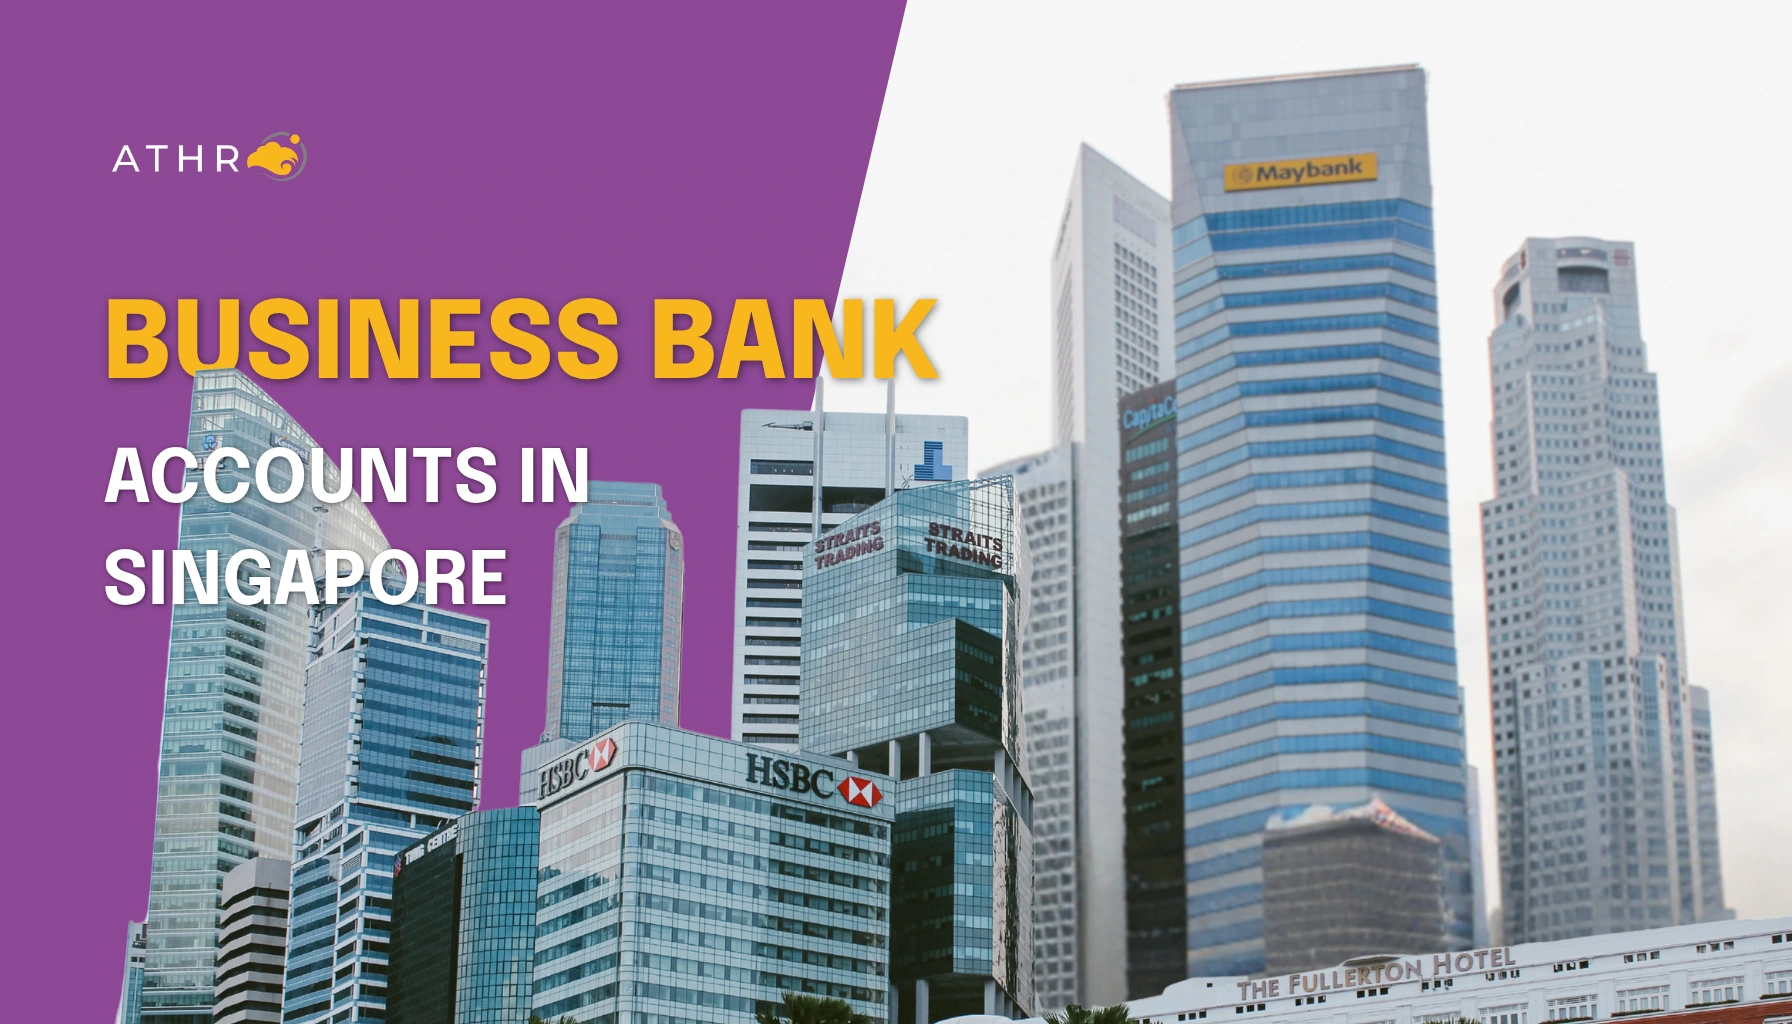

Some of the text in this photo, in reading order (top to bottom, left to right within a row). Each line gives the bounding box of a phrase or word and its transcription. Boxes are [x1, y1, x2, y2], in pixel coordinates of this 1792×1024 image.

[1256, 157, 1363, 183] Maybank
[814, 520, 881, 554] STRAITS
[814, 536, 885, 570] TRADING
[924, 537, 1003, 569] TRADING
[928, 521, 1004, 552] STRAITS
[537, 749, 590, 801] HSBC
[745, 752, 835, 799] HSBC
[427, 823, 459, 853] CENTRE
[1236, 947, 1517, 1001] THE FULLERTON HOTEL
